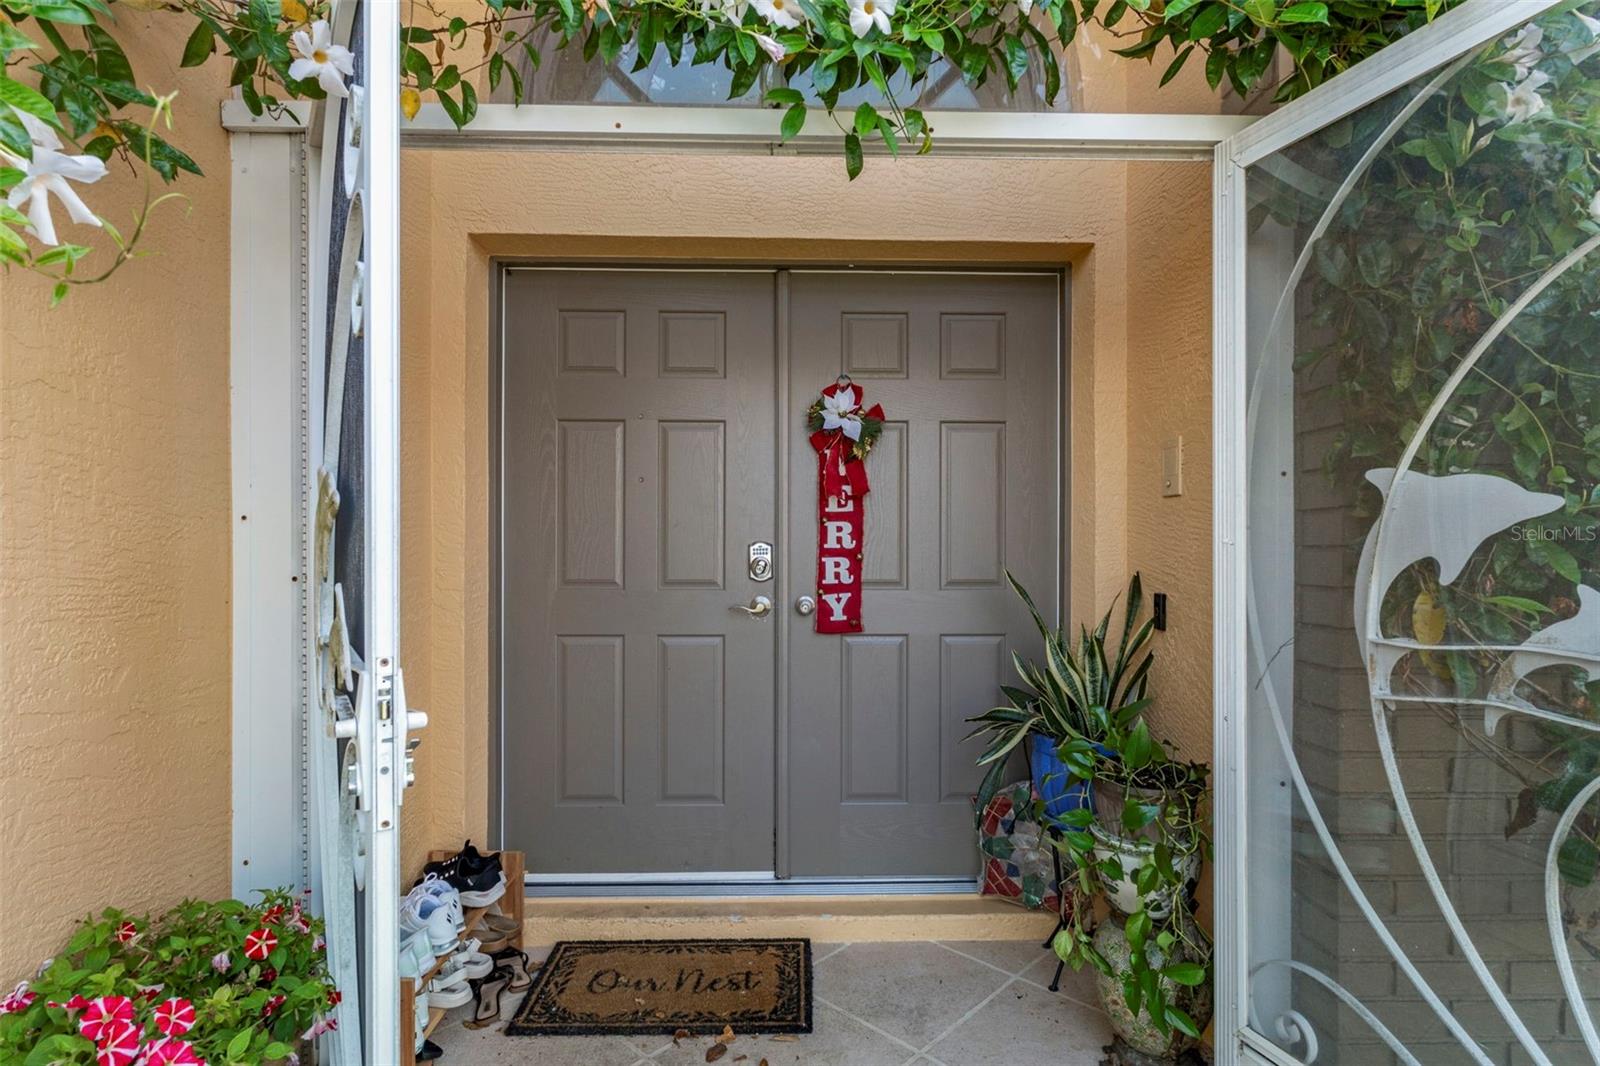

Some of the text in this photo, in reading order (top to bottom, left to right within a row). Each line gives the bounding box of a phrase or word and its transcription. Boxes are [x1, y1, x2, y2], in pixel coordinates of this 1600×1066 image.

[822, 449, 856, 621] ERRY
[586, 968, 762, 994] Our Nest
